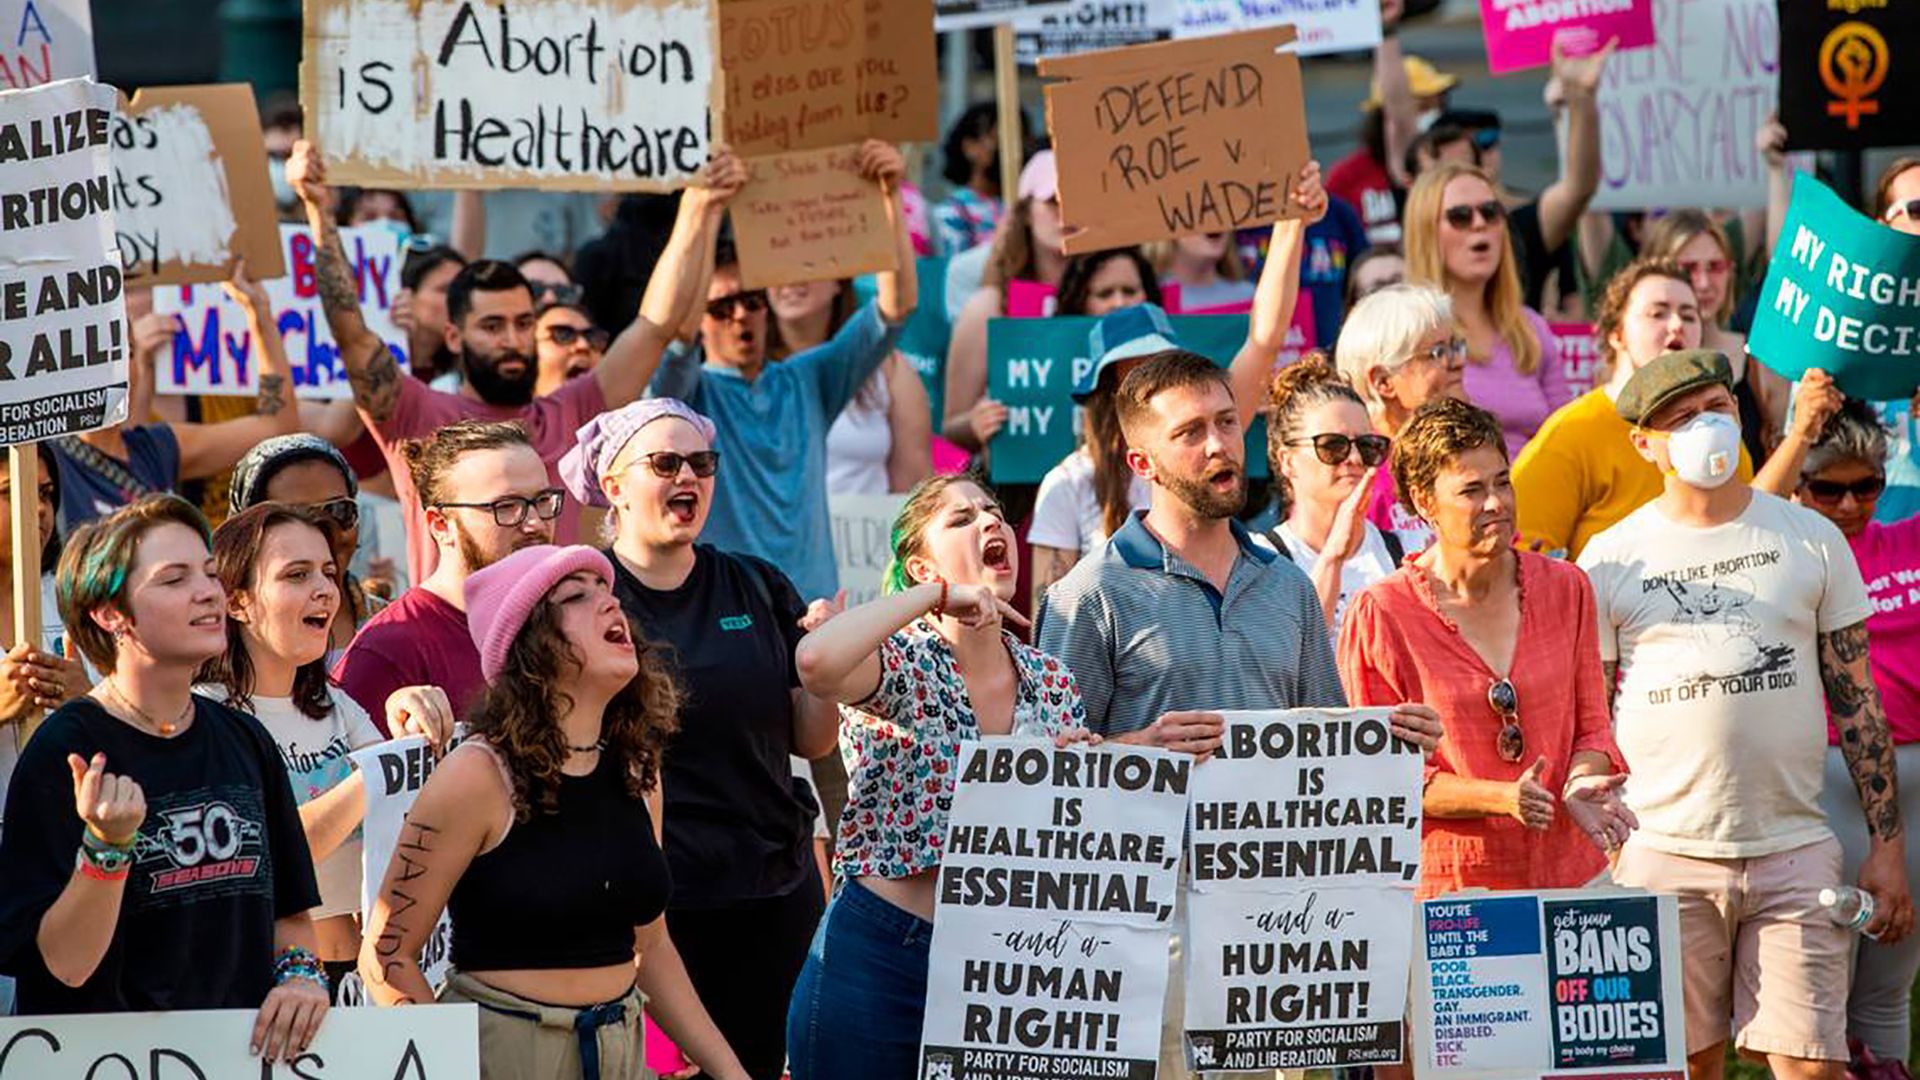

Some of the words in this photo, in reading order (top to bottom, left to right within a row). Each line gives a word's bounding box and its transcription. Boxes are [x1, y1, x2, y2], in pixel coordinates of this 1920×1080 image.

[17, 0, 52, 46] A
[439, 2, 694, 84] Abortion
[338, 51, 395, 114] is
[434, 97, 713, 179] Healthcare!
[1110, 126, 1200, 191] ROE
[2, 176, 109, 231] RTION
[1158, 172, 1291, 232] WADE!
[1790, 223, 1826, 272] MY
[36, 265, 122, 316] AND
[1774, 277, 1811, 326] MY
[1813, 305, 1920, 355] DECI
[25, 320, 123, 378] ALL!
[172, 306, 251, 386] My
[1007, 356, 1052, 388] MY
[2, 404, 32, 423] FOR
[1008, 405, 1054, 437] MY
[1680, 565, 1708, 583] LIKE
[1678, 682, 1712, 701] OFF
[1718, 675, 1765, 697] YOUR
[960, 747, 1191, 795] ABORTION
[1299, 767, 1325, 796] IS
[1053, 797, 1082, 827] IS
[1195, 796, 1418, 831] HEALTHCARE,
[948, 825, 1177, 871] HEALTHCARE,
[1194, 836, 1419, 882] ESSENTIAL,
[940, 865, 1175, 922] ESSENTIAL,
[1427, 903, 1473, 918] YOU'RE
[1428, 917, 1480, 930] PRO-LIFE
[1429, 931, 1464, 944] UNTIL
[1467, 930, 1489, 942] THE
[1222, 940, 1370, 977] HUMAN
[1430, 945, 1462, 957] BABY
[1465, 944, 1477, 956] IS
[1431, 960, 1471, 973] POOR.
[1554, 926, 1652, 976] BANS
[963, 960, 1123, 1003] HUMAN
[1432, 974, 1475, 987] BLACK.
[1432, 985, 1525, 1000] TRANSGENDER.
[1555, 979, 1588, 1003] OFF
[1593, 977, 1631, 1000] OUR
[1226, 982, 1370, 1025] RIGHT!
[1433, 1001, 1463, 1014] GAY.
[1434, 1014, 1453, 1026] AN
[1455, 1010, 1532, 1026] IMMIGRANT.
[963, 1004, 1120, 1052] RIGHT!
[1225, 1030, 1273, 1048] PARTY
[1276, 1028, 1304, 1046] FOR
[1306, 1025, 1378, 1044] SOCIALISM
[1435, 1026, 1496, 1040] DISABLED.
[1557, 1001, 1660, 1043] BODIES
[963, 1050, 1015, 1071] PARTY
[1018, 1055, 1050, 1073] FOR
[1051, 1056, 1130, 1078] SOCIALISM
[1223, 1051, 1256, 1069] AND
[1258, 1048, 1337, 1068] LIBERATION
[1436, 1040, 1467, 1053] SICK.
